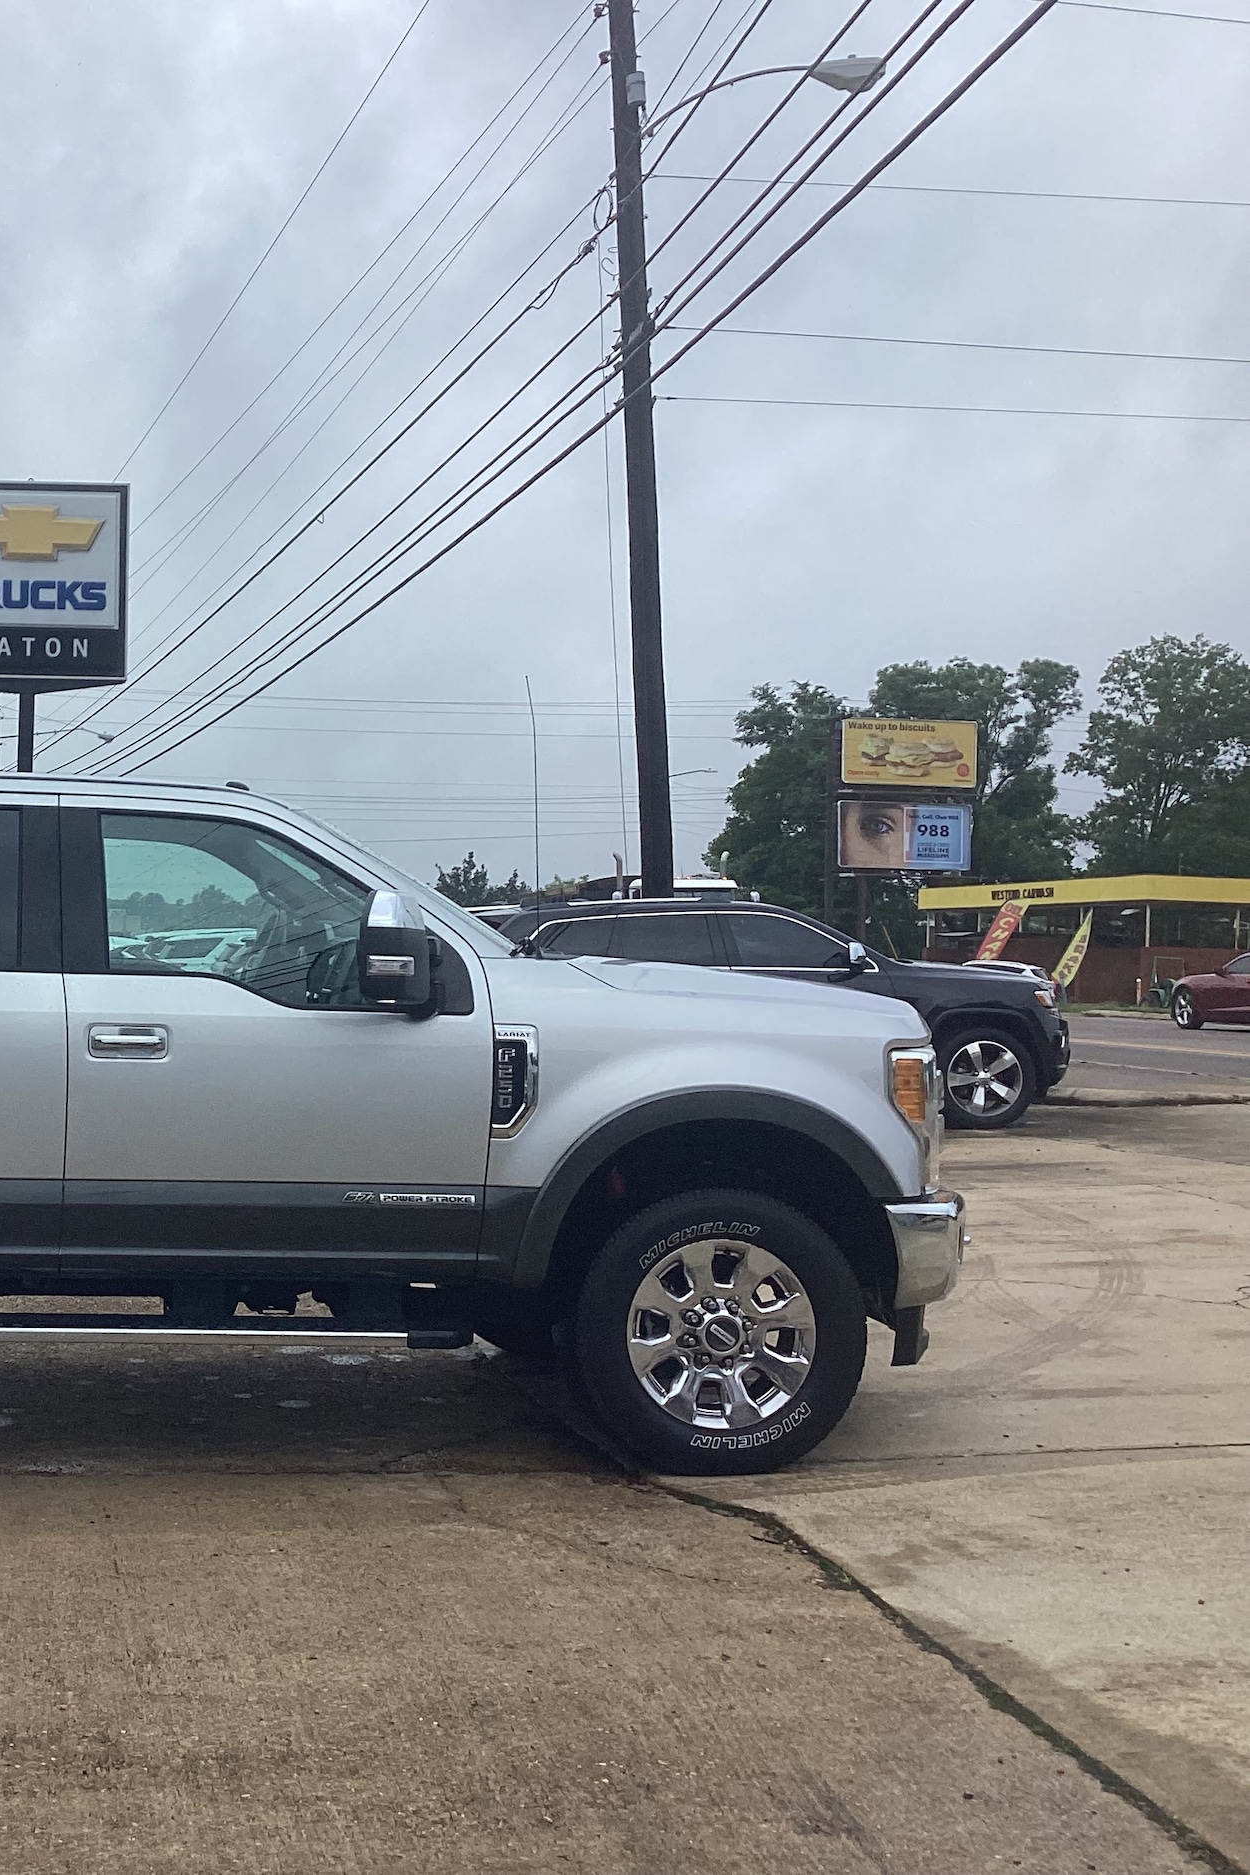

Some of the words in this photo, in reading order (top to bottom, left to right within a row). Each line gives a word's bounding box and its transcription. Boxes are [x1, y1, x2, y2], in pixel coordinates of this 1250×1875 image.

[848, 721, 873, 730] Wake
[875, 723, 887, 732] up
[888, 722, 898, 731] to
[899, 722, 936, 732] biscuits
[847, 769, 864, 777] Open
[917, 824, 950, 837] 988
[980, 917, 1014, 960] CHAN
[383, 1195, 423, 1203] POWER
[639, 1221, 761, 1270] MICHELIN
[690, 1402, 811, 1450] MICHELIN
